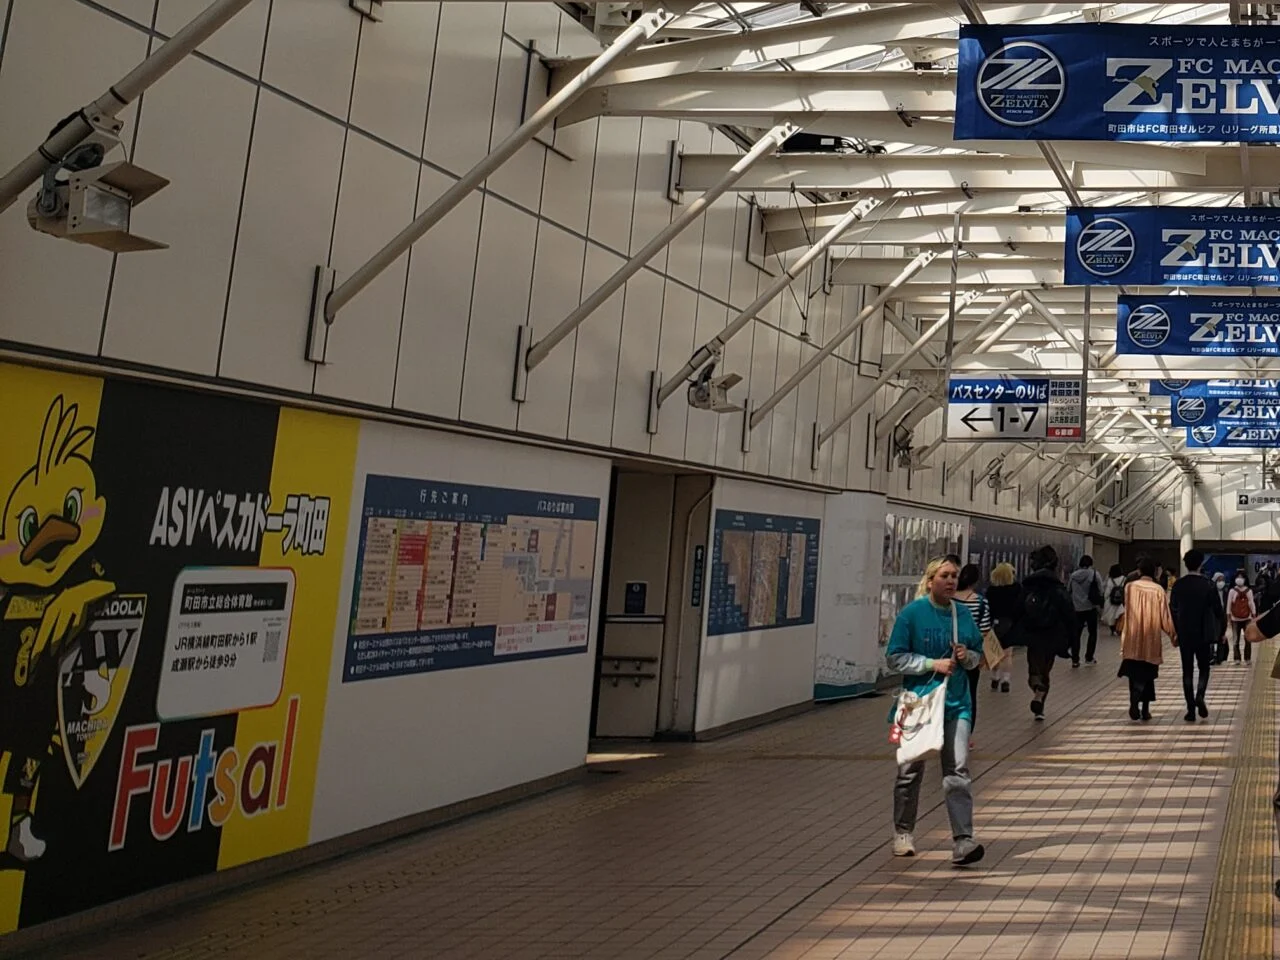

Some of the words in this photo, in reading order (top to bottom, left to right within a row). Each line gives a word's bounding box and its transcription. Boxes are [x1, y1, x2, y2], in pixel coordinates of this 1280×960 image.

[1177, 58, 1214, 75] FC
[990, 94, 1050, 108] ZELVIA
[1208, 230, 1233, 240] FC
[1225, 313, 1244, 322] FC
[952, 383, 1048, 400] バスセンターのりば
[997, 406, 1039, 433] 1-7
[149, 485, 330, 557] ASVペスカドーラ町田
[108, 695, 301, 852] Futsal
